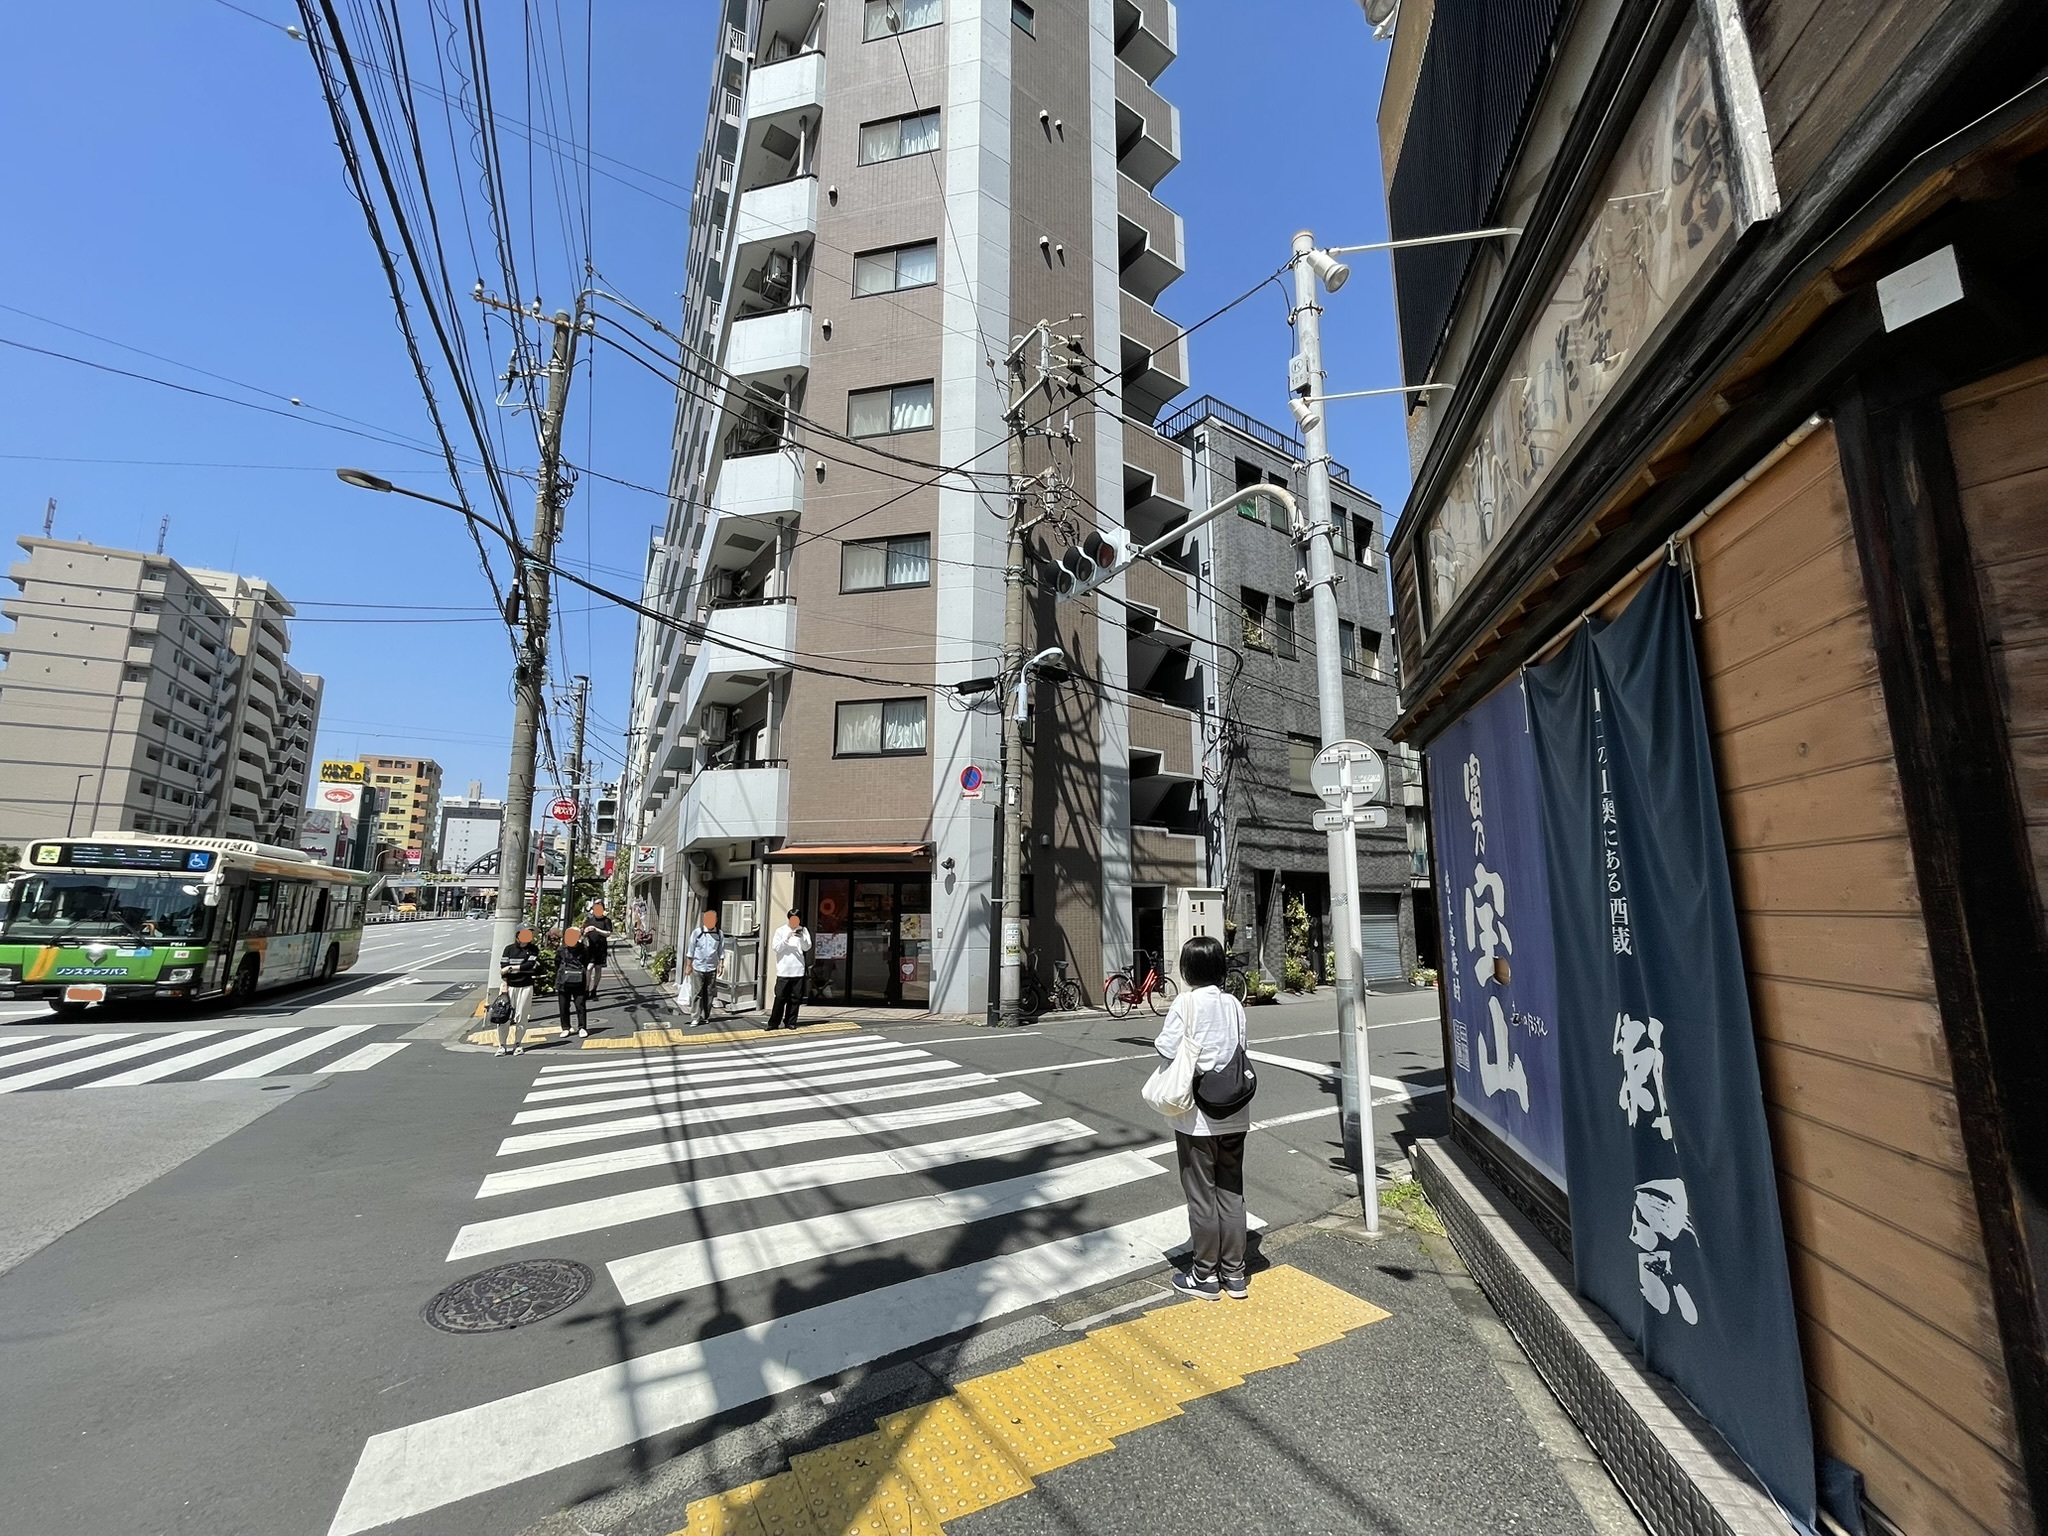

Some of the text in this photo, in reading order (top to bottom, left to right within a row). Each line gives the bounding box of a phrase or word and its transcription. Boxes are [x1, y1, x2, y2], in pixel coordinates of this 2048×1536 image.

[321, 769, 362, 780] WORLD
[56, 967, 128, 976] ノンステップバス
